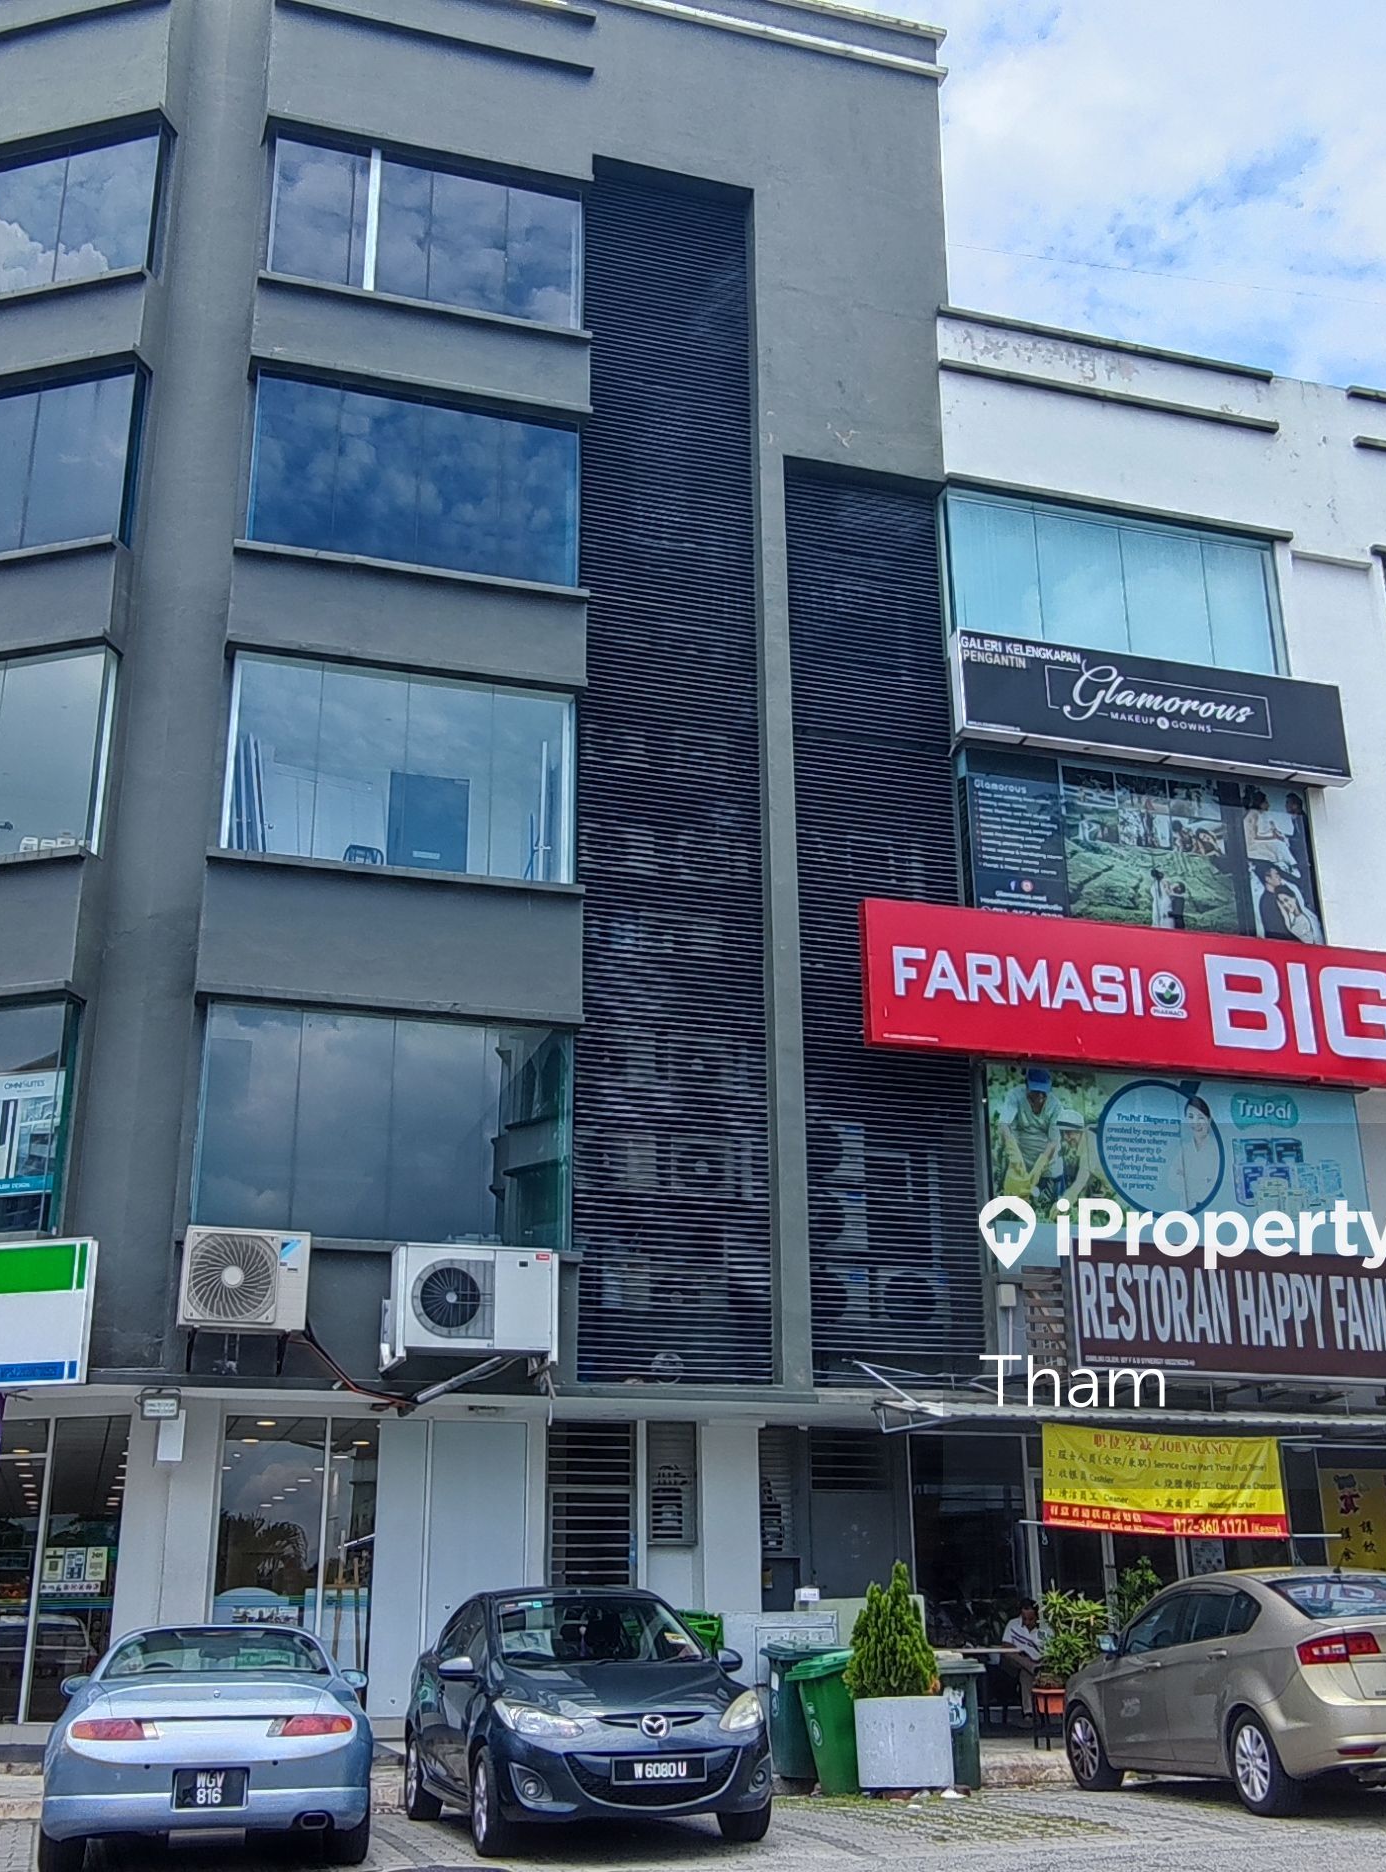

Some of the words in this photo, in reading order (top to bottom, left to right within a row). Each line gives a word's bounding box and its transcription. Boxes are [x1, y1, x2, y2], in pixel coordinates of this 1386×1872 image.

[960, 636, 1002, 653] GALERI
[1005, 642, 1081, 665] KELENGKAPAN
[963, 650, 1026, 669] PENGANTIN
[1063, 659, 1255, 723] Glamorous
[1110, 711, 1156, 726] MAKEUP
[1171, 720, 1212, 733] GOWNS
[974, 779, 1027, 794] Glamorous
[892, 945, 1145, 1016] FARMASI
[1236, 1098, 1292, 1120] TruPal
[1078, 1261, 1232, 1345] RESTORAN
[1234, 1270, 1325, 1349] HAPPY
[1160, 1441, 1181, 1453] JOB
[1182, 1441, 1233, 1456] VACANCY
[1154, 1460, 1179, 1470] Service
[634, 1763, 643, 1779] W
[645, 1762, 677, 1778] 6080
[678, 1761, 687, 1776] U
[197, 1772, 225, 1788] WGV
[197, 1788, 222, 1804] 816
